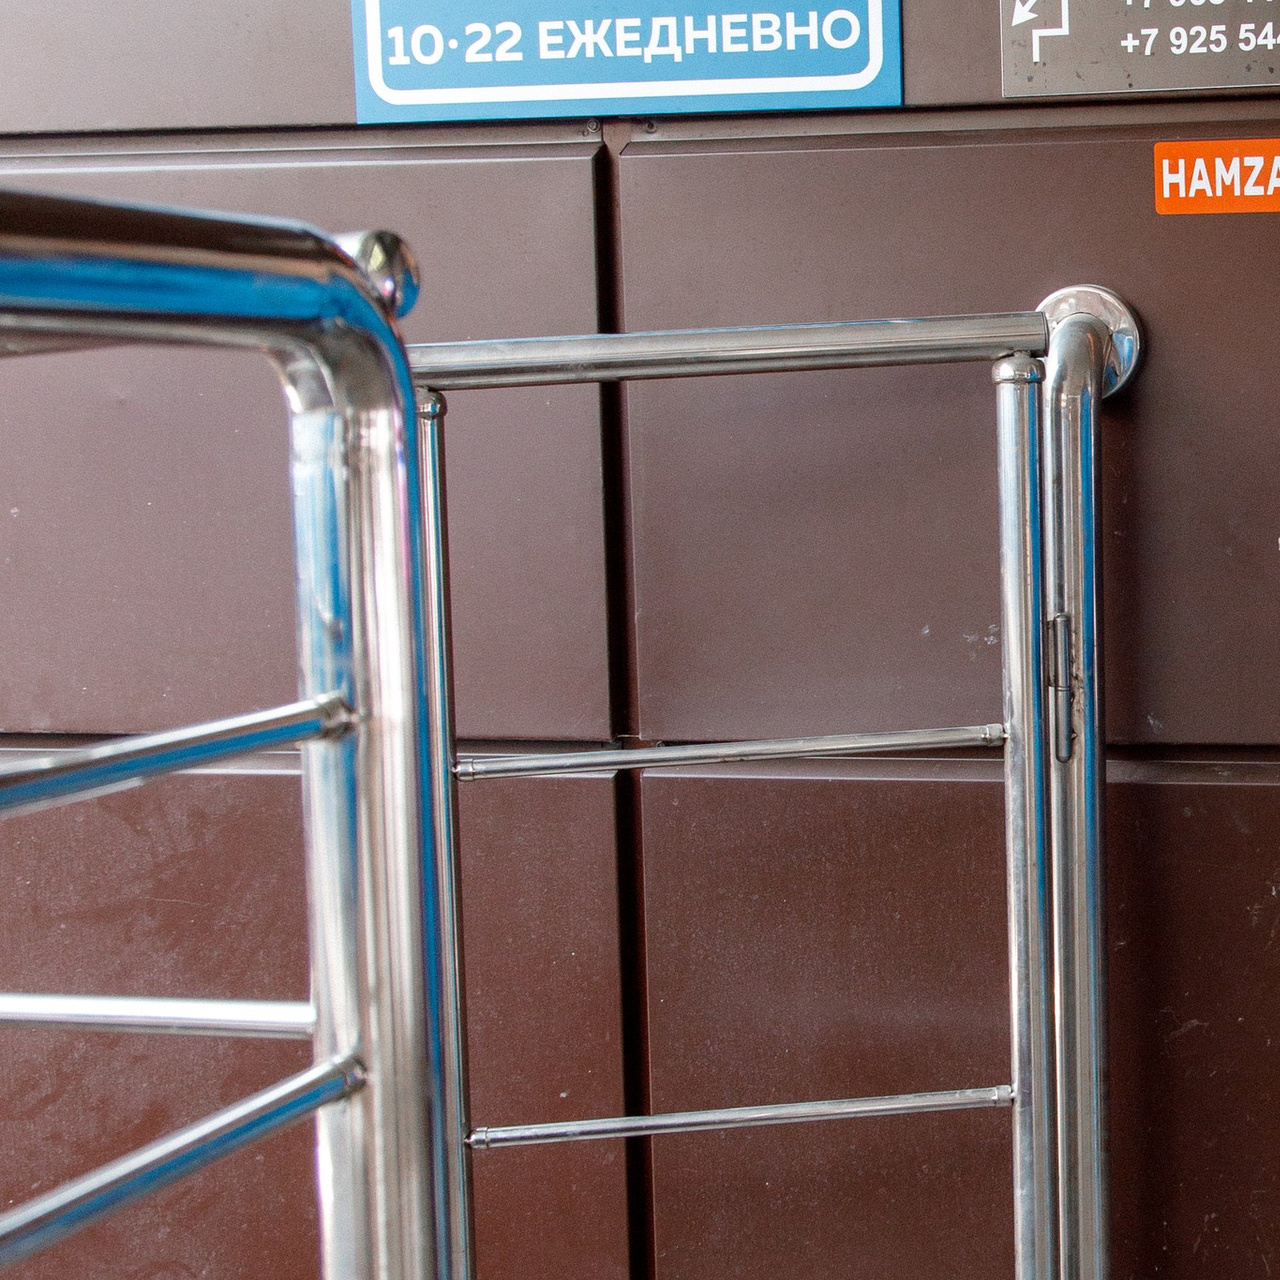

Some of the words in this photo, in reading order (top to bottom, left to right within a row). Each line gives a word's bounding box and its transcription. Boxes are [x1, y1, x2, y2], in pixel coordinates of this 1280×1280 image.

[540, 9, 861, 64] ЕЖЕДНЕВНО
[1120, 28, 1158, 56] +7
[1169, 24, 1227, 55] 925
